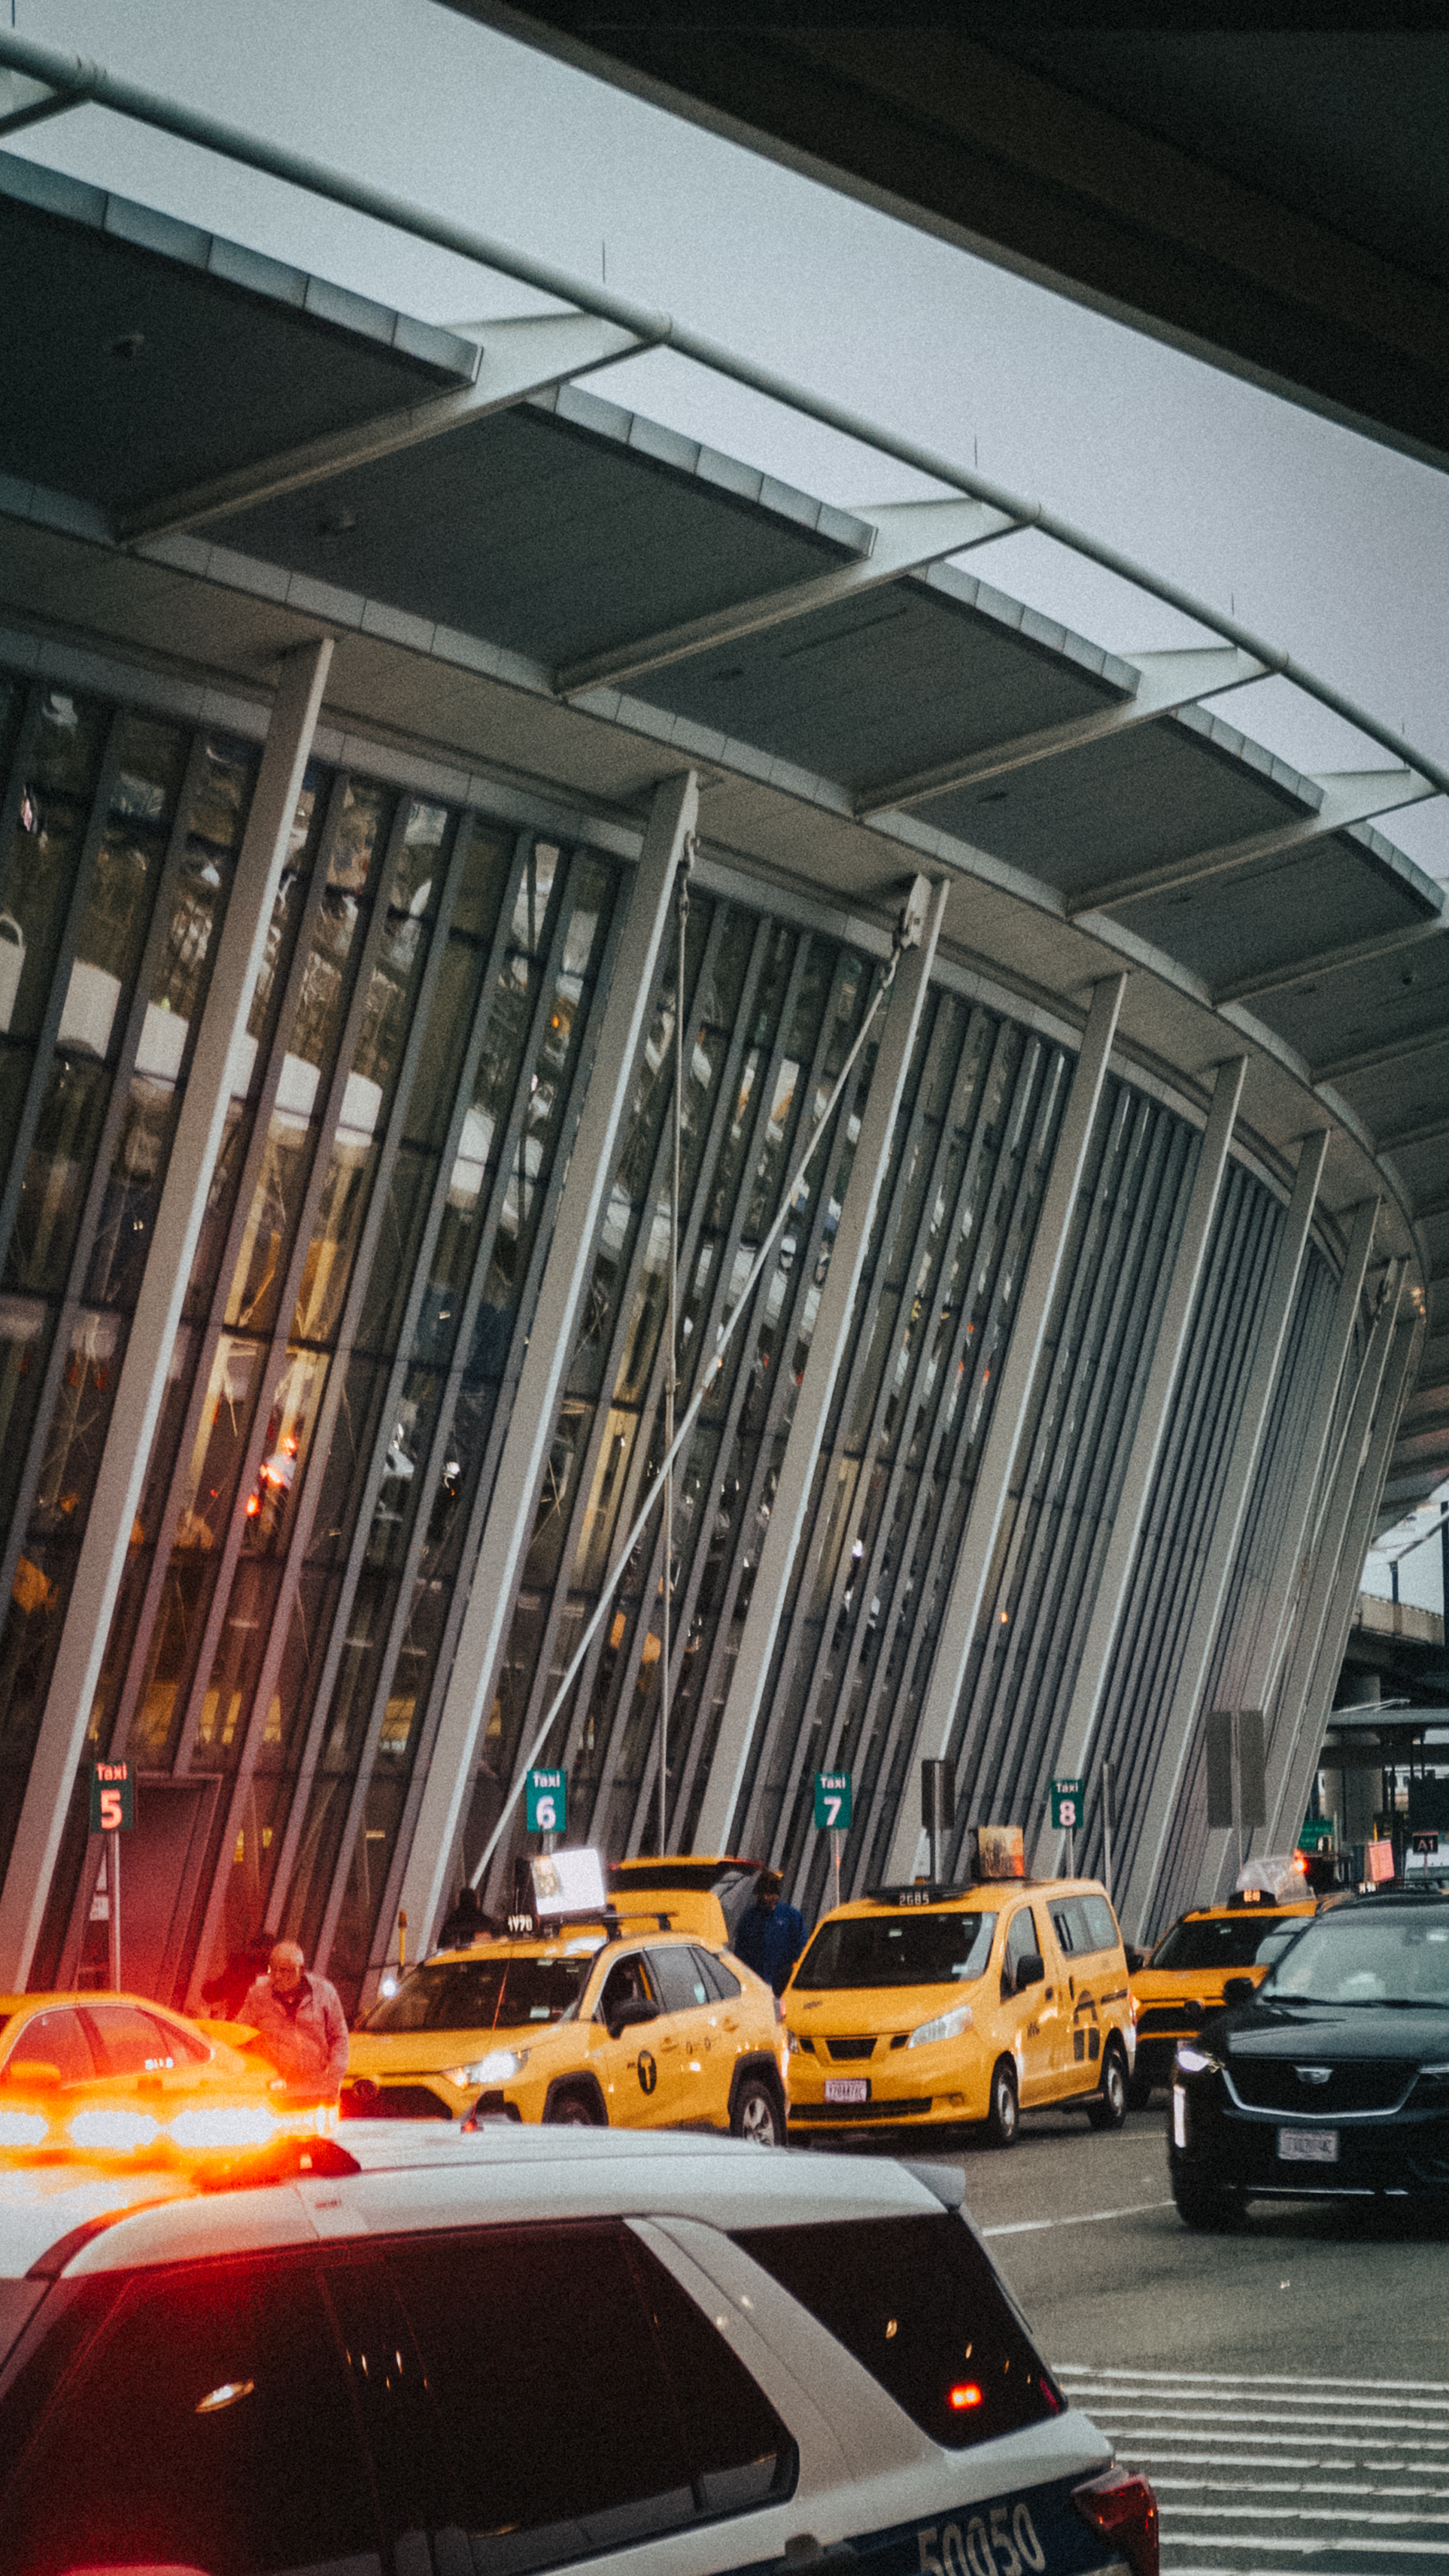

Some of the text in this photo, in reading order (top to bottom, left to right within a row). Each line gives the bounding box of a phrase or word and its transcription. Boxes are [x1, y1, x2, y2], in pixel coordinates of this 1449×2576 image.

[96, 1761, 127, 1781] Taxi
[533, 1771, 560, 1788] Taxi
[820, 1776, 846, 1789] Taxi
[1056, 1782, 1079, 1793] Taxi
[101, 1789, 123, 1829] 5
[536, 1795, 556, 1830] 6
[824, 1796, 842, 1826] 7
[1059, 1800, 1077, 1826] 8
[1417, 1839, 1433, 1851] A1
[917, 2503, 1046, 2576] 50050
